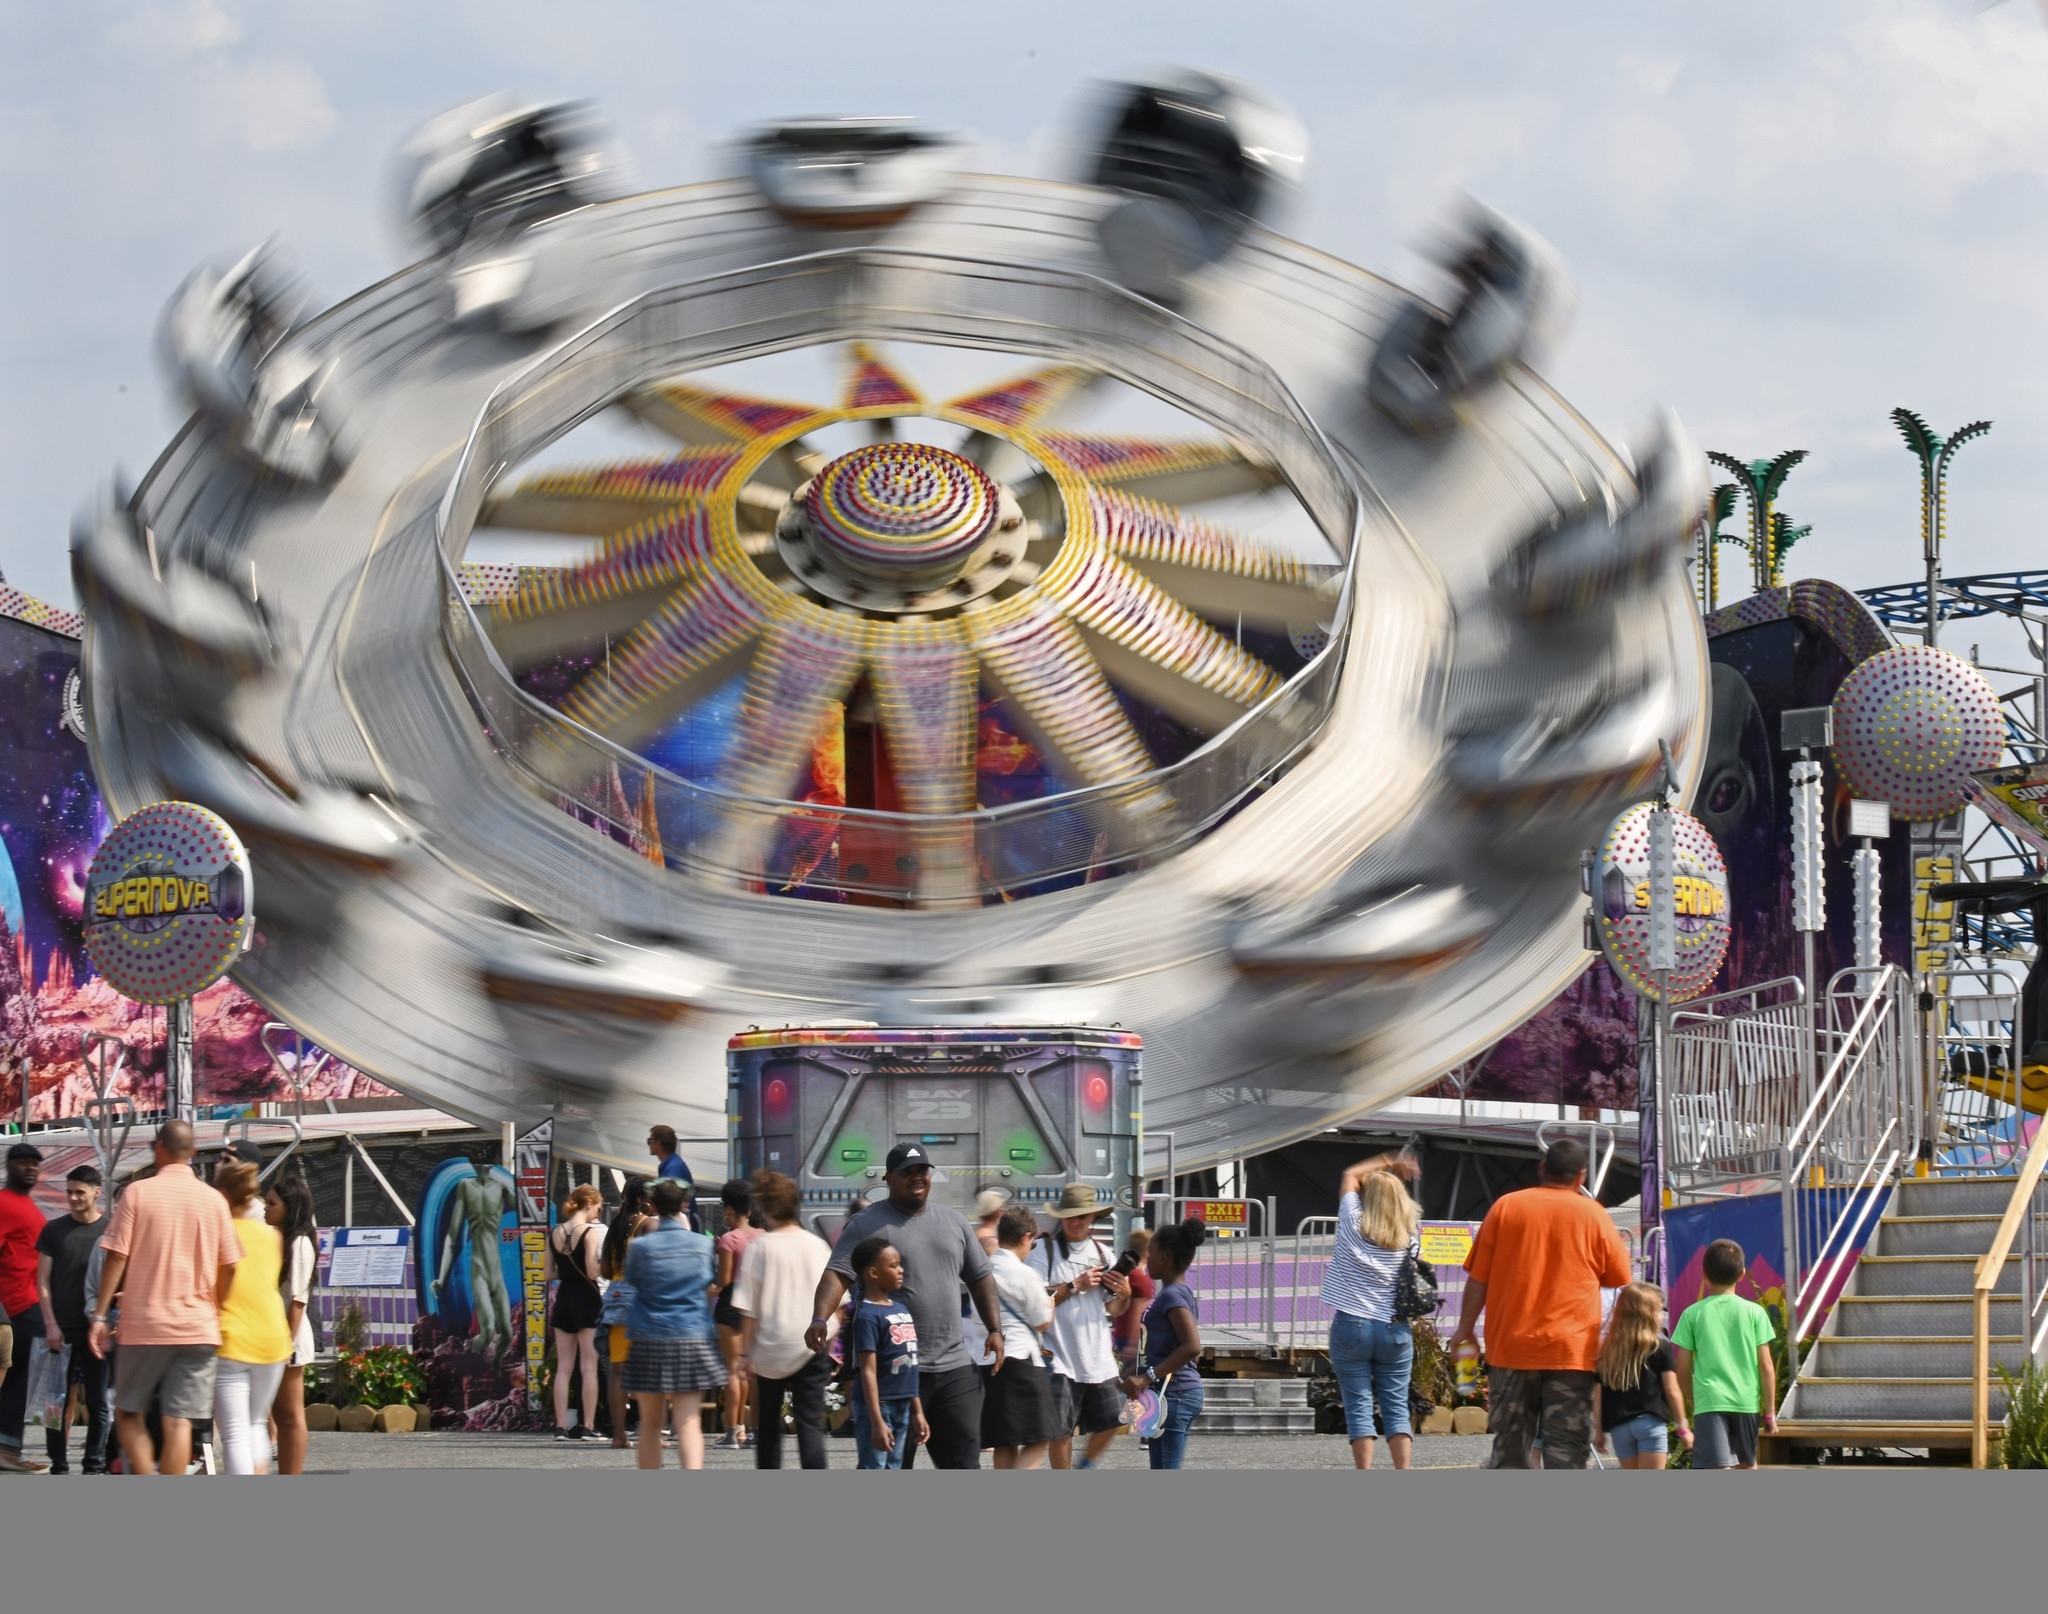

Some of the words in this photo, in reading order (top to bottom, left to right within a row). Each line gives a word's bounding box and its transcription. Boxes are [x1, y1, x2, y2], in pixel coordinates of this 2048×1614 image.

[95, 876, 210, 917] SUPERNOVA
[1635, 876, 1725, 916] SERNOVA
[907, 1089, 971, 1098] BAY
[907, 1101, 972, 1120] 23
[1206, 1203, 1243, 1215] EXIT
